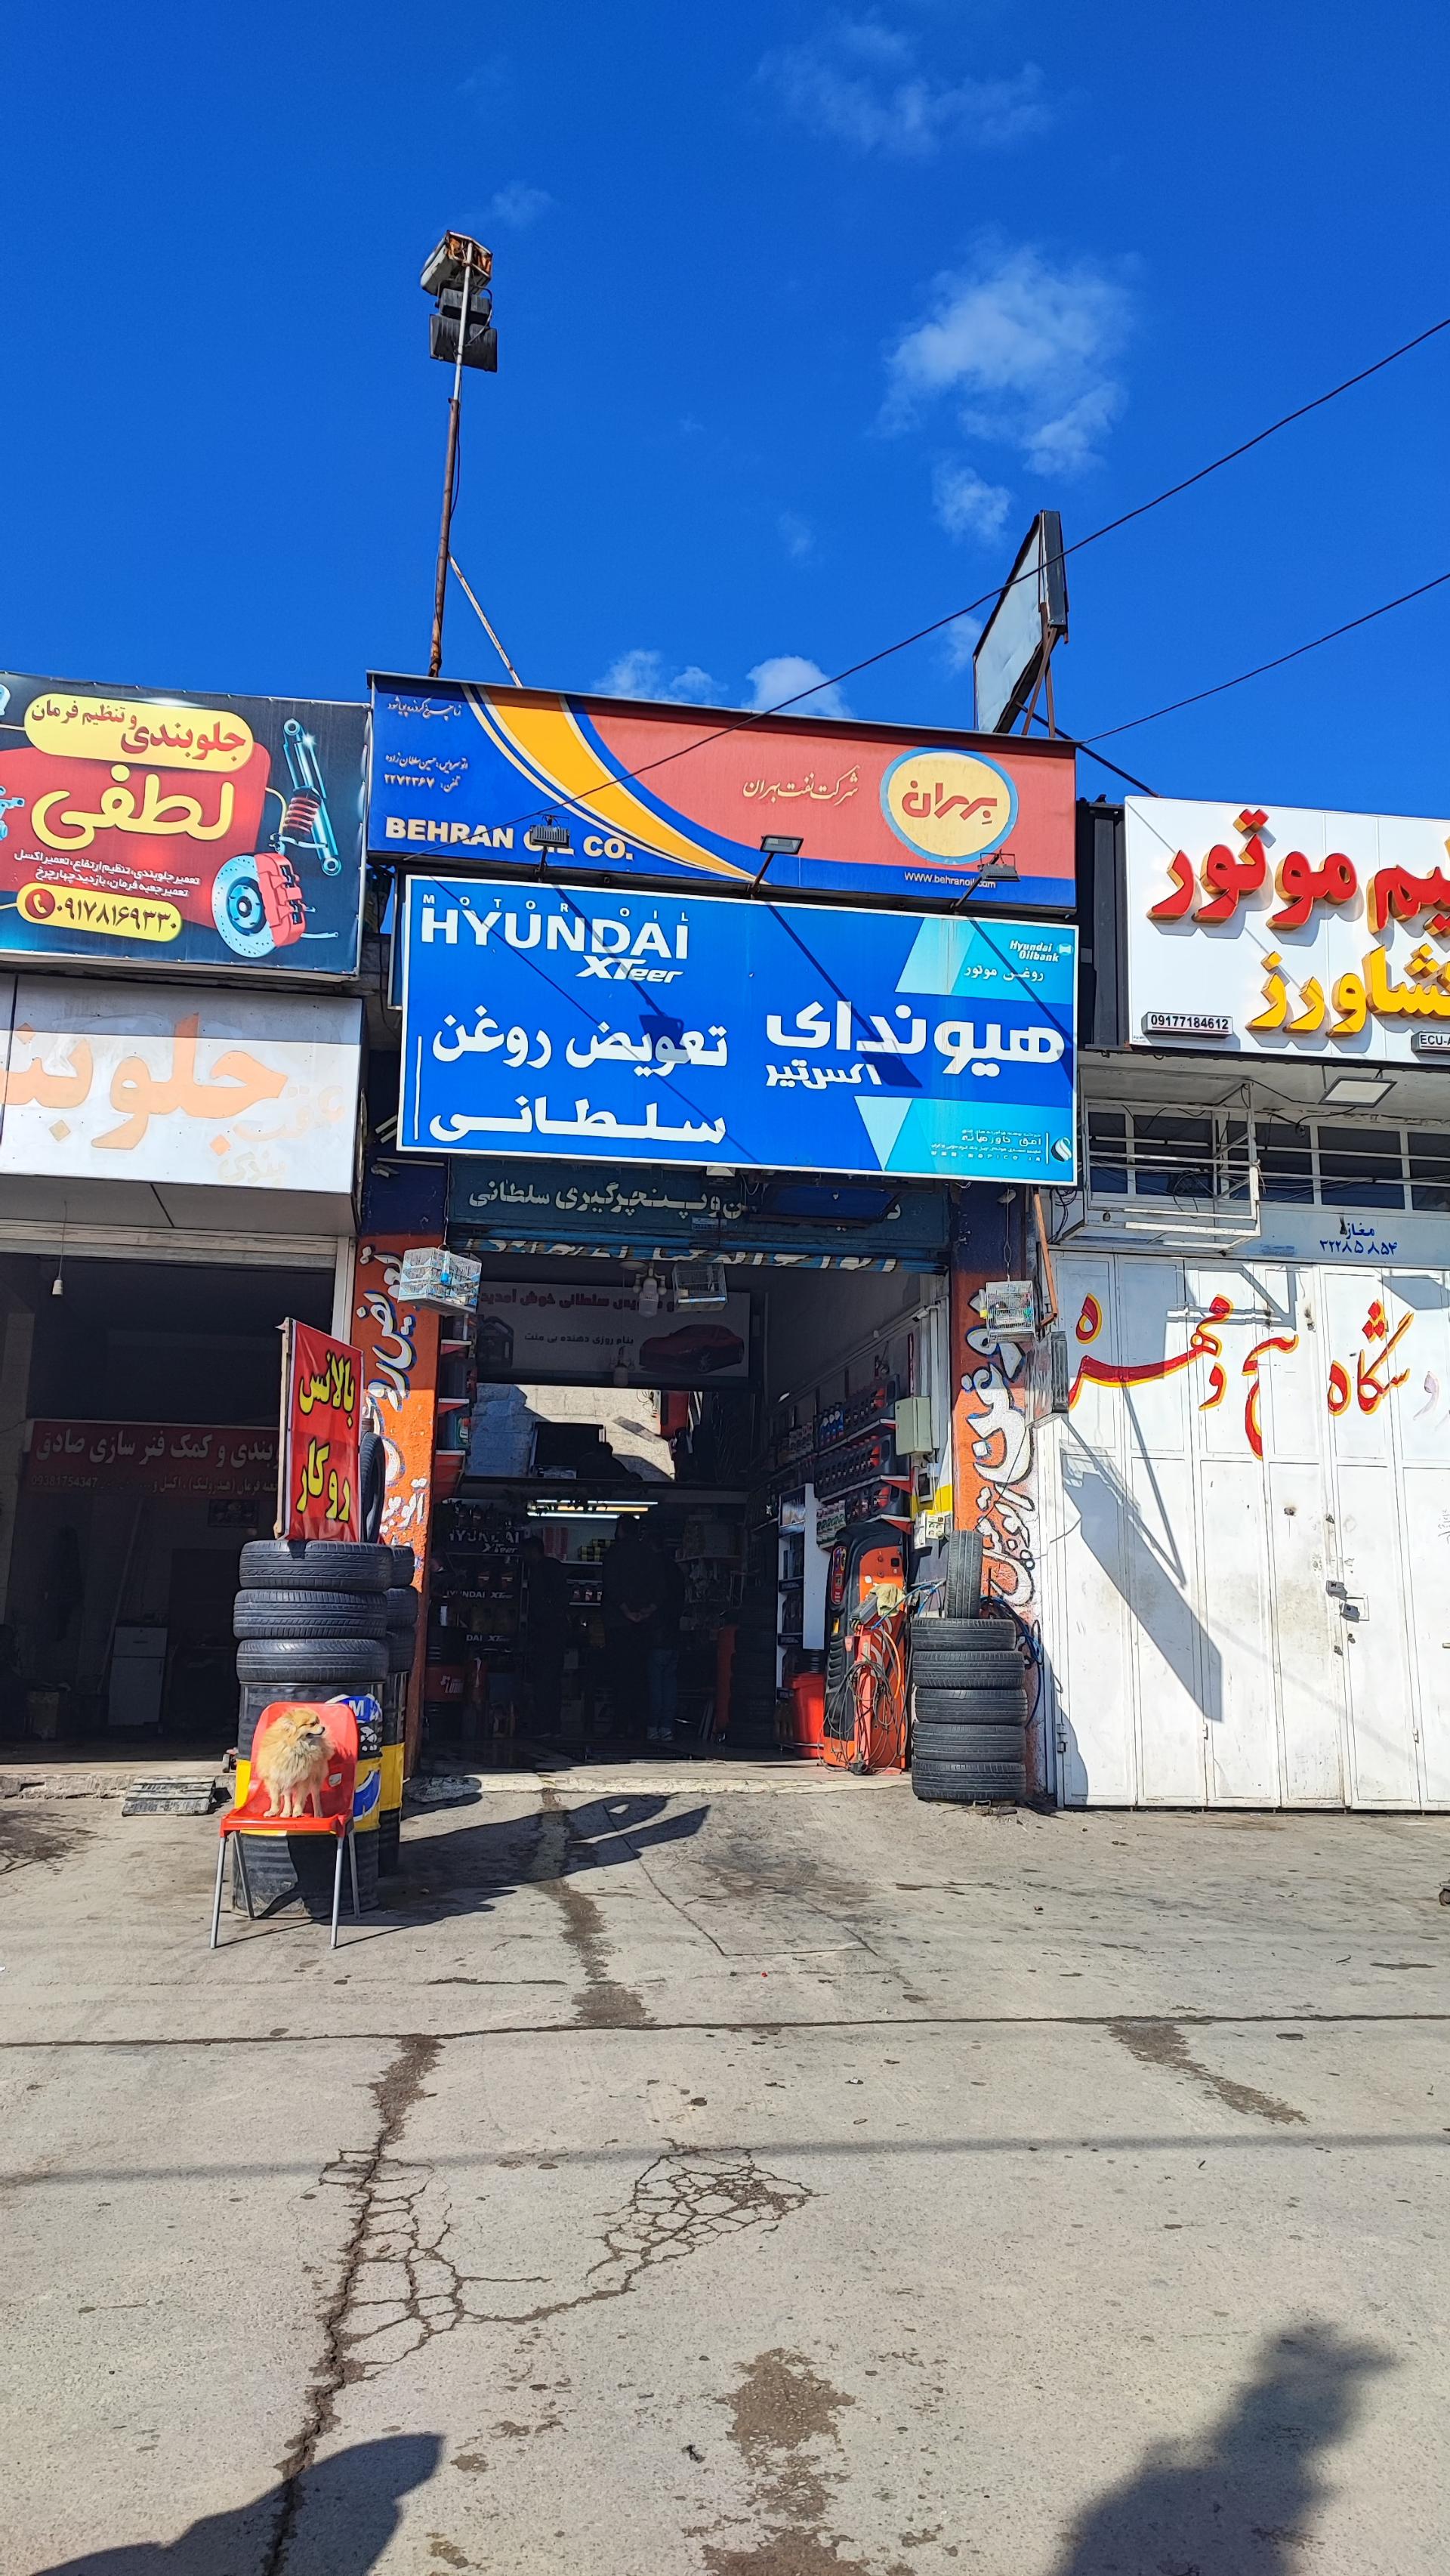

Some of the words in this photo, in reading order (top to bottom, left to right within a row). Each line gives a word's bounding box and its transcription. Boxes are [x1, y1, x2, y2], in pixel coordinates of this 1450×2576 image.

[31, 700, 79, 721] فرمان
[82, 705, 126, 725] تنظیم
[121, 720, 246, 761] جلوبندی
[31, 764, 236, 851] لطفی
[384, 817, 514, 849] BEHRAN
[582, 836, 634, 860] CO.
[1146, 808, 1359, 931] موتور
[421, 907, 690, 960] HYUNDAI
[1009, 940, 1054, 953] Hyundai
[575, 955, 684, 984] XTeer
[963, 965, 998, 980] موتور
[1017, 950, 1060, 962] Oilbank
[1003, 967, 1044, 982] روغن
[432, 1005, 553, 1069] روغن
[1150, 1014, 1229, 1030] 09177184612
[565, 1021, 729, 1078] تعویض
[766, 1000, 1066, 1078] هیوندای
[429, 1095, 727, 1144] سلطانی
[468, 1178, 551, 1207] سلطانی
[35, 1428, 85, 1461] صادق
[88, 1429, 136, 1464] سازی
[170, 1432, 214, 1459] کمک
